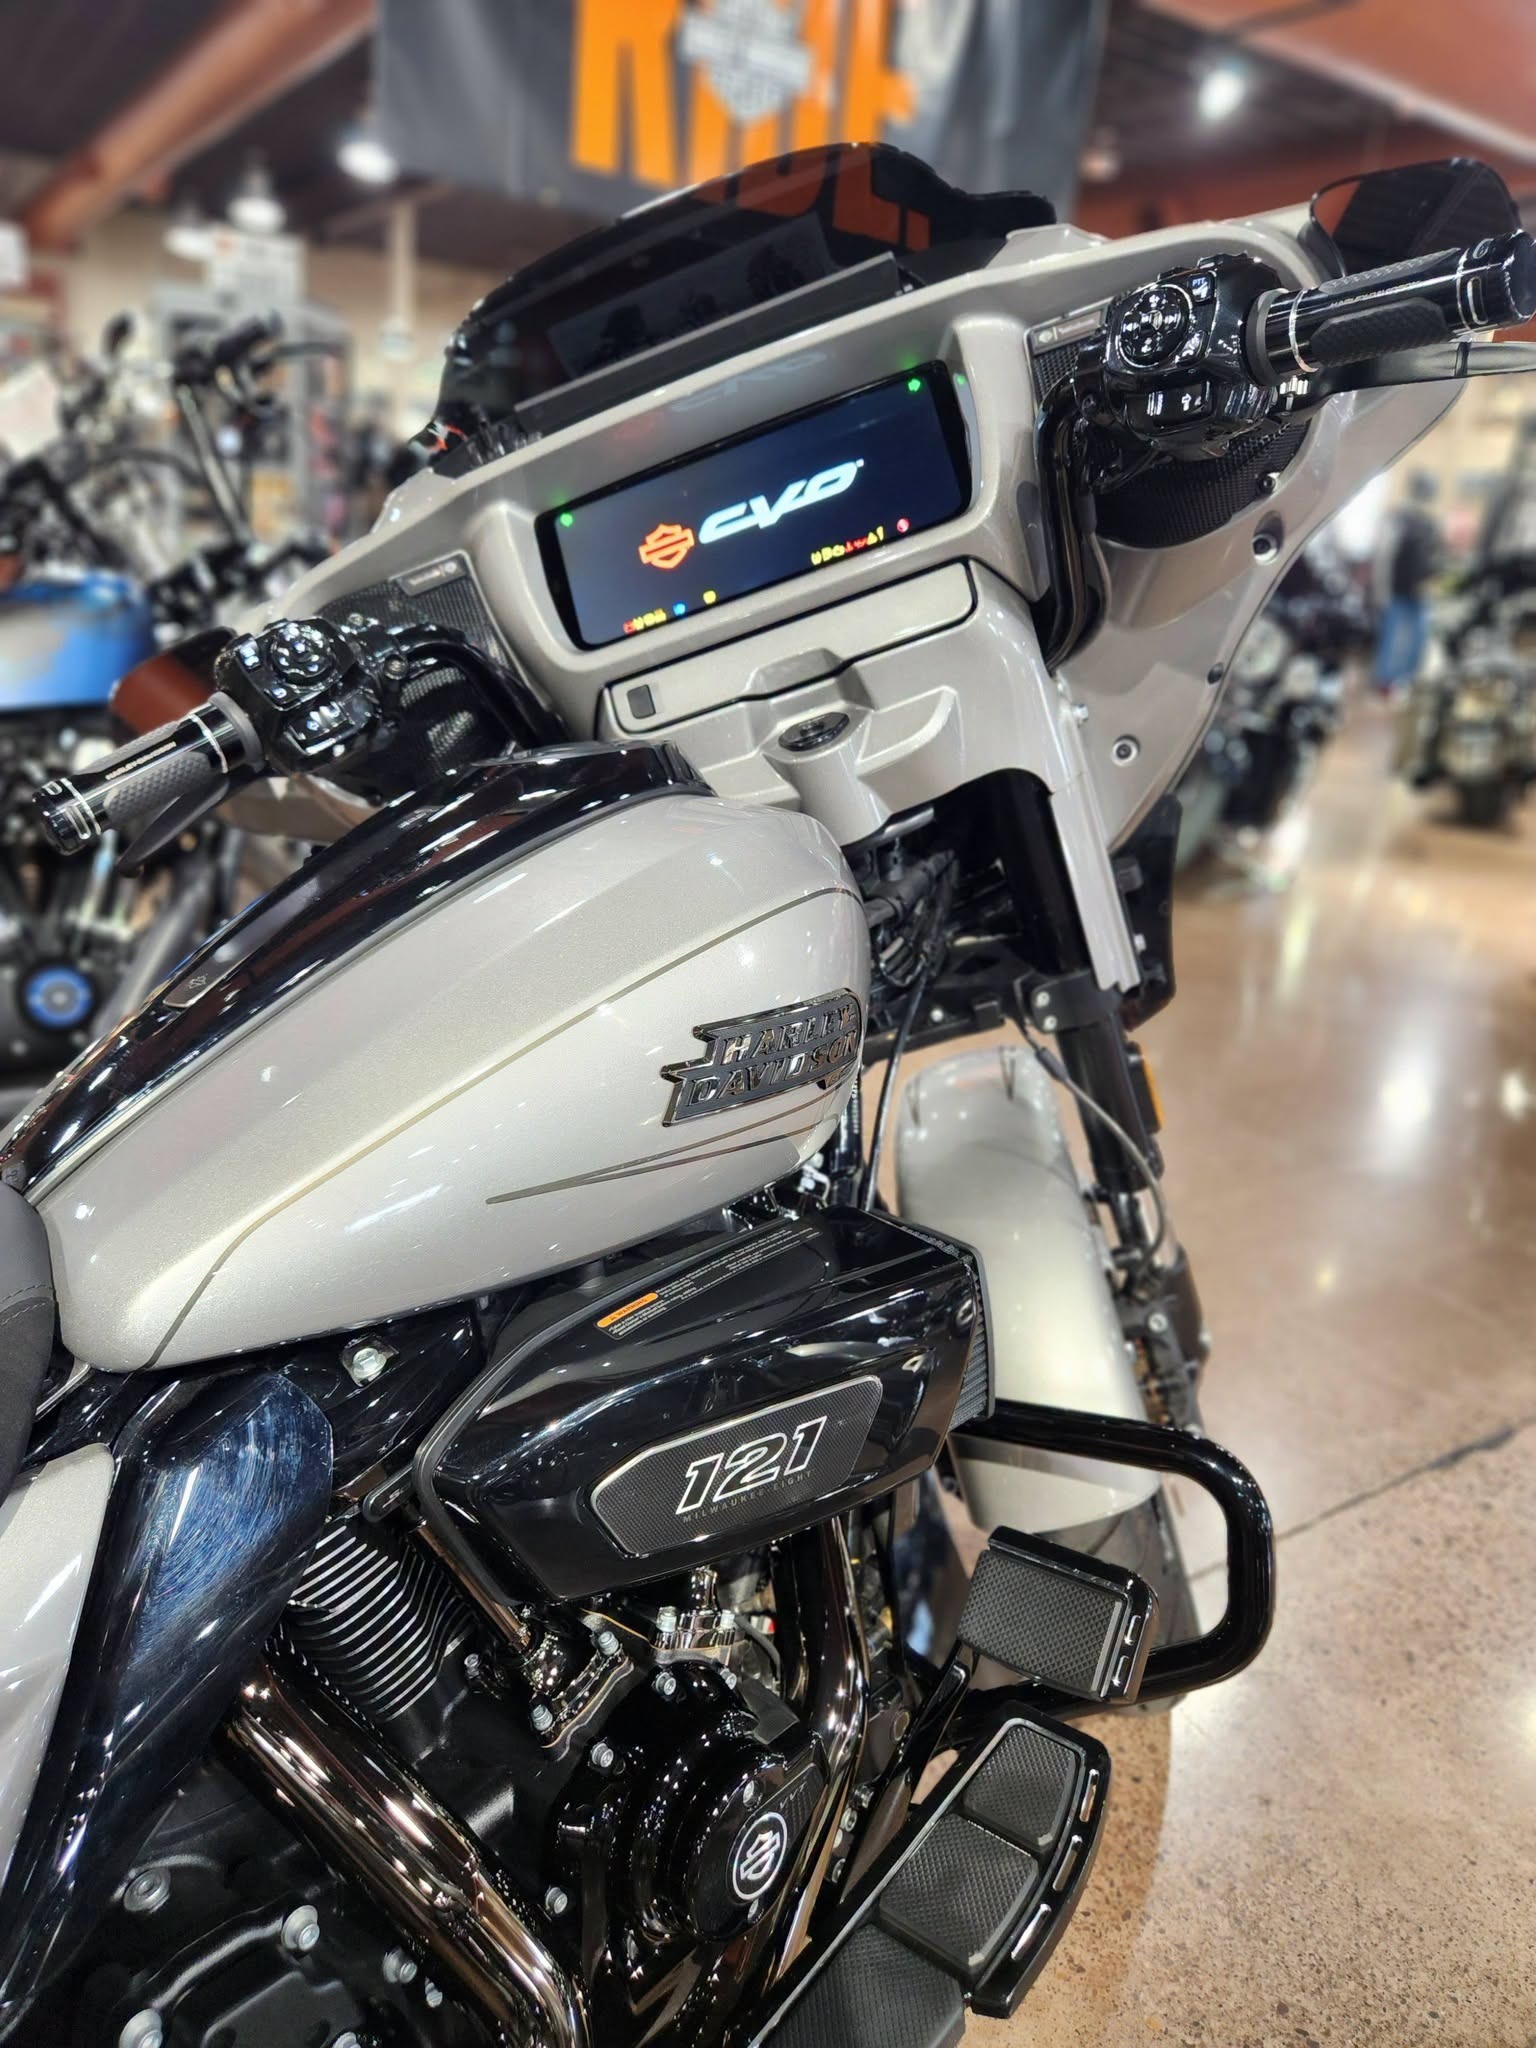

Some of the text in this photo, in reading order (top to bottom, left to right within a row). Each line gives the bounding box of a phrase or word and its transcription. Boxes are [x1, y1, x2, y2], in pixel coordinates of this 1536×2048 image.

[698, 458, 858, 545] CVO
[687, 1029, 858, 1106] DAVIDSON
[721, 1003, 856, 1065] HARLEY
[676, 1415, 828, 1515] 121
